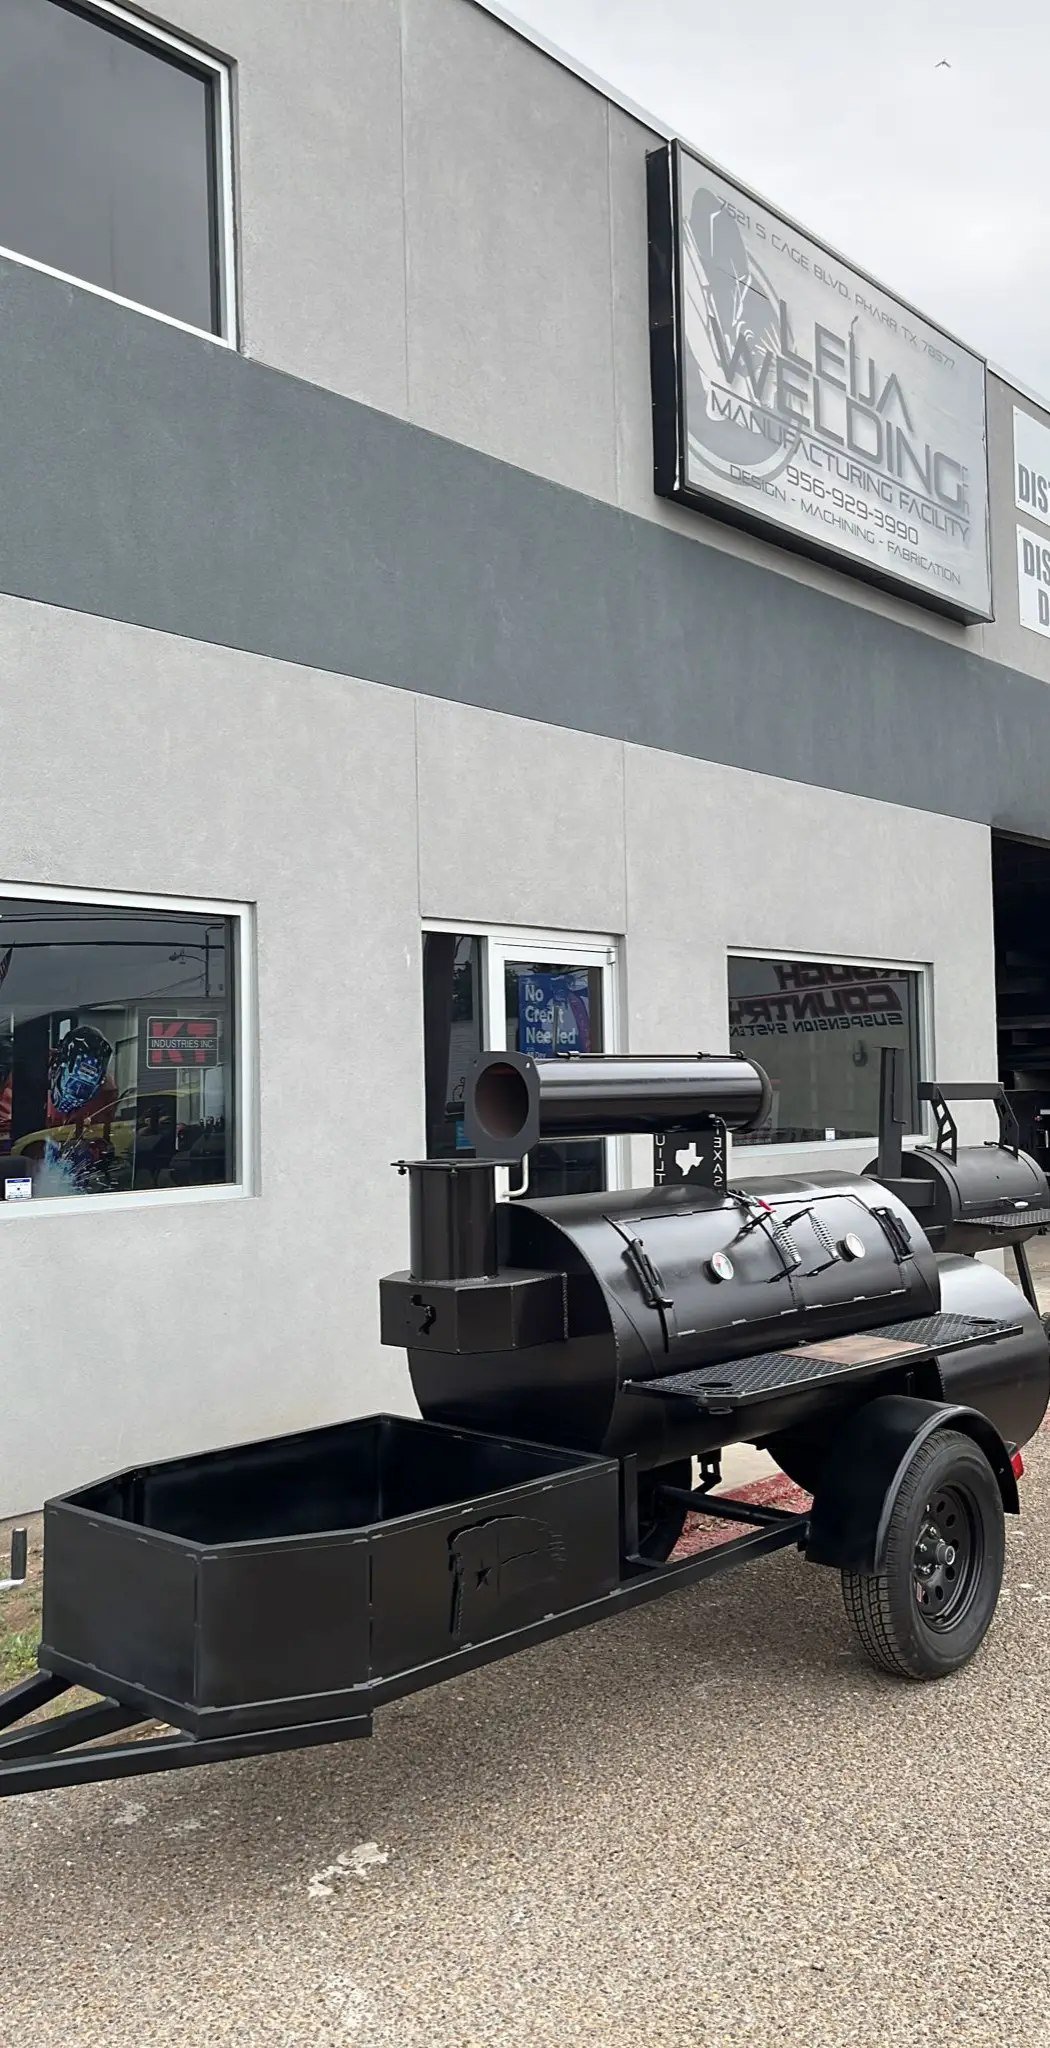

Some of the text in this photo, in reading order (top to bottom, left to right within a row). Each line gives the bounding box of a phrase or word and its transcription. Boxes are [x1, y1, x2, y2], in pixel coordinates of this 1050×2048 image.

[717, 196, 751, 231] 7521
[755, 223, 767, 240] S
[771, 234, 811, 272] CAGE
[855, 294, 898, 333] PHARR
[901, 326, 918, 346] TX
[921, 340, 956, 369] 78577
[707, 313, 963, 506] WELDING
[780, 298, 915, 433] LEIJA
[711, 390, 970, 543] MANUFACTURING FACILITY
[786, 465, 919, 546] 956-929-3990
[1018, 463, 1050, 514] DIS
[730, 464, 787, 502] DESIGN
[800, 499, 875, 545] MACHINING
[887, 541, 961, 585] FABRICATION
[151, 1039, 199, 1048] INDUSTRIES
[525, 984, 545, 1002] No
[525, 1005, 565, 1024] Credt
